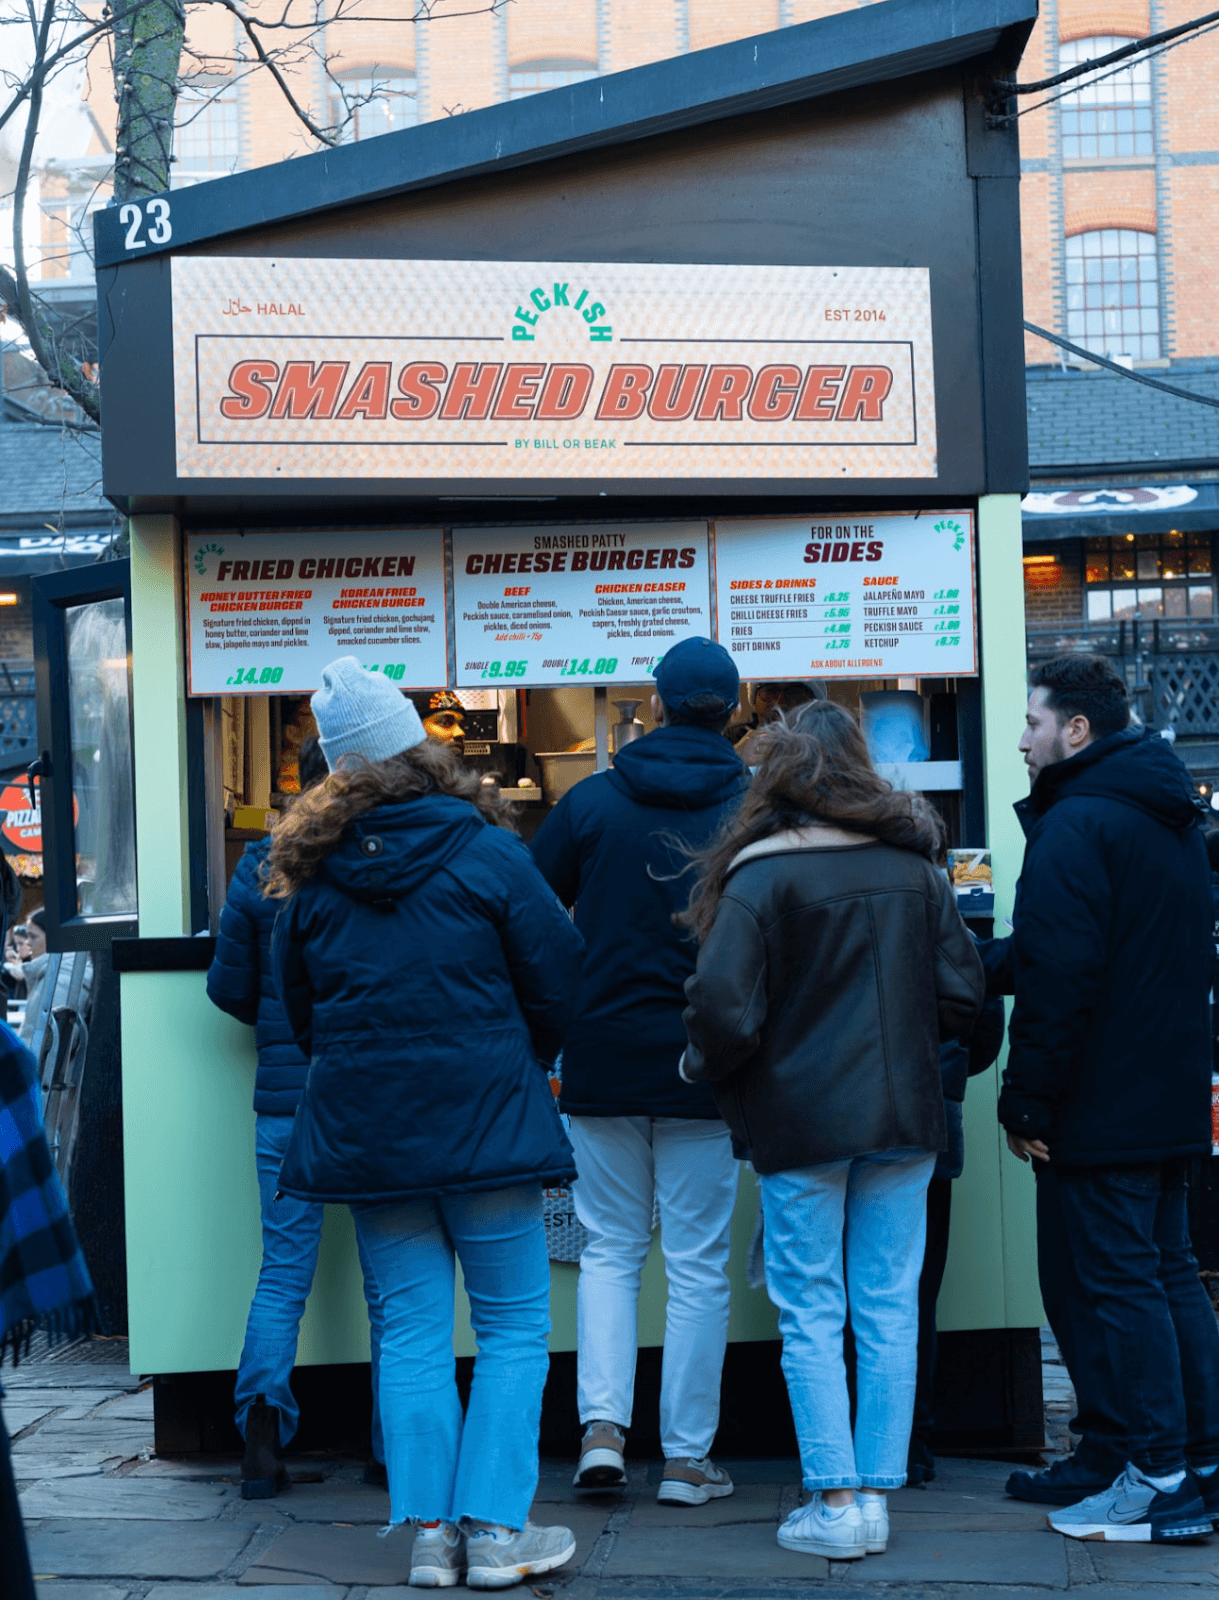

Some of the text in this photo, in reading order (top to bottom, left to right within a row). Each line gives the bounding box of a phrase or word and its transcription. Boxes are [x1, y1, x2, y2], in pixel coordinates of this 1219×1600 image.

[119, 198, 172, 250] 23
[257, 303, 306, 316] HALAL
[512, 282, 613, 342] PECKISH
[824, 309, 886, 322] EST 2014
[220, 359, 894, 422] SMASHED BURGER
[514, 438, 617, 450] BY BILL OR BEAK
[811, 524, 874, 540] FOR ON THE
[933, 520, 966, 552] PECKISH
[534, 533, 626, 550] SMASHED PATTY
[803, 541, 884, 564] SIDES
[465, 547, 697, 575] CHEESE BURGERS
[217, 556, 416, 582] FRIED CHICKEN
[594, 581, 687, 594] CHICKEN CEASER
[730, 578, 817, 590] SIDES & DRINKS
[862, 576, 899, 587] SAUCE
[200, 589, 313, 602] HONEY BUTTER FRIED
[340, 587, 417, 599] KOREAN FRIED
[503, 586, 531, 597] BEEF
[863, 588, 903, 601] JALAPEÑO
[903, 589, 925, 600] MAYO
[332, 597, 426, 610] CHICKEN BURGER
[477, 599, 558, 610] Double American cheese,
[597, 595, 684, 607] Chicken, American cheese,
[730, 594, 759, 605] CHEESE
[760, 593, 792, 604] TRUFFLE
[793, 592, 815, 603] FRIES
[209, 600, 304, 613] CHICKEN BURGER
[579, 608, 606, 618] Peckish
[629, 608, 651, 617] sauce,
[651, 606, 671, 617] garlic
[671, 605, 703, 616] croutons,
[863, 606, 896, 617] TRUFFLE
[896, 605, 918, 616] MAYO
[323, 612, 435, 626] Signature fried chicken, gochujang
[463, 609, 574, 621] Peckish sauce, caramelised onion,
[730, 610, 755, 621] CHILLI
[756, 609, 785, 620] CHEESE
[786, 608, 808, 619] FRIES
[203, 616, 311, 630] Signature fried chicken, dipped in
[328, 623, 431, 636] dipped, coriander and lime slaw,
[483, 620, 554, 632] pickles, diced onions.
[592, 617, 691, 630] capers, freshly grated cheese,
[864, 621, 898, 633] PECKISH
[898, 620, 924, 632] SAUCE
[205, 627, 309, 640] honey butter, coriander and lime
[494, 633, 509, 642] Add
[508, 632, 526, 642] chilli
[607, 627, 677, 640] pickles, diced onions.
[731, 625, 754, 637] FRIES
[205, 639, 223, 650] slaw,
[251, 639, 271, 650] mayo
[270, 638, 284, 648] and
[284, 637, 310, 649] pickles.
[337, 634, 423, 646] smacked cucumber slices.
[732, 641, 751, 652] SOFT
[751, 640, 781, 652] DRINKS
[864, 637, 900, 649] KETCHUP
[542, 657, 619, 677] DOUBLE £14.00
[631, 656, 655, 666] TRIPLE
[810, 658, 883, 669] ASK ABOUT ALLERGENS
[464, 659, 529, 679] SINGLE £9.95
[226, 666, 284, 686] £14.00
